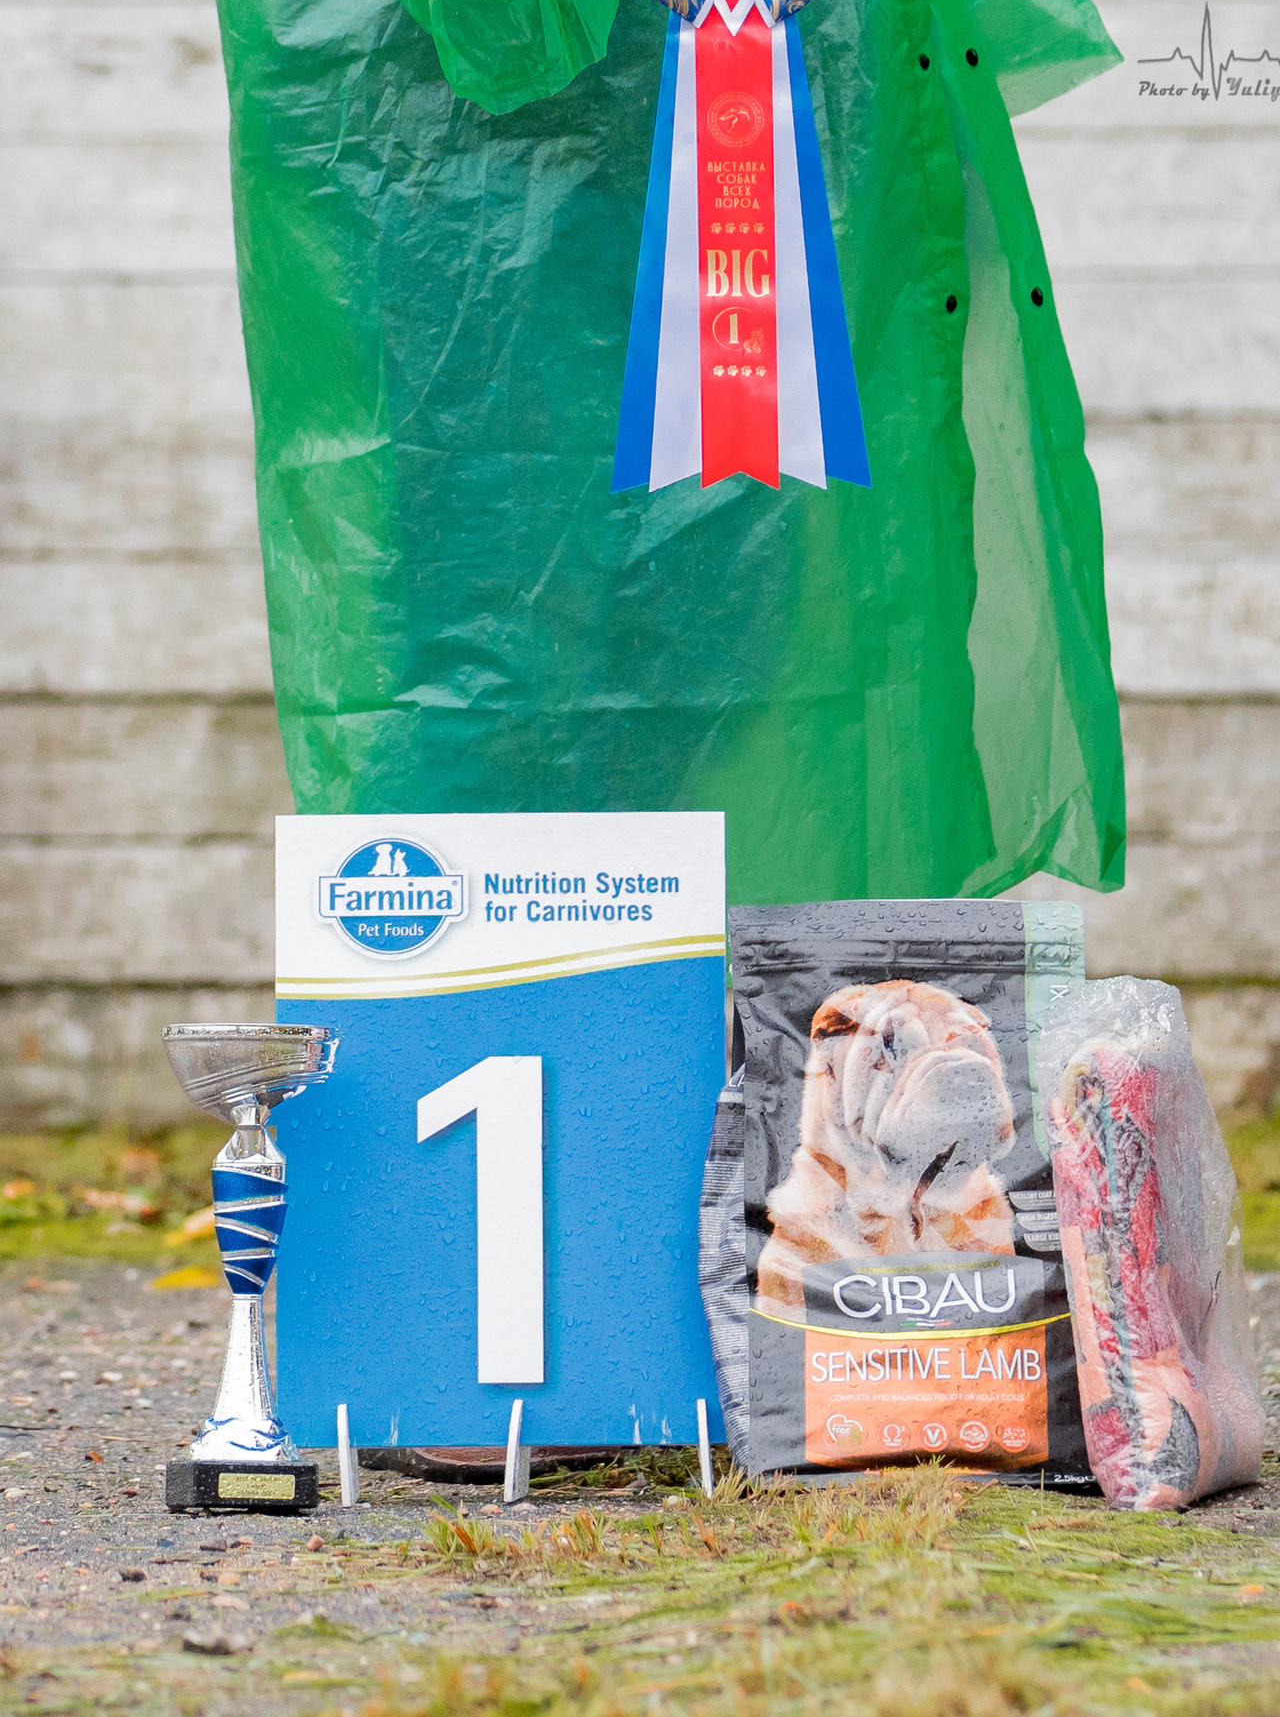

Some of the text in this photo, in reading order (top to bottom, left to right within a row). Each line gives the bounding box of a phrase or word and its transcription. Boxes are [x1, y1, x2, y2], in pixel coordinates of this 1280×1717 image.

[707, 161, 766, 173] ВЫСТАВКА
[716, 173, 758, 185] СОБАК
[723, 185, 752, 196] ВСЕХ
[715, 197, 760, 209] ПОРОД
[706, 248, 771, 298] BIG
[728, 312, 740, 345] 1
[329, 882, 453, 912] Farmina
[484, 871, 681, 899] Nutrition System
[484, 899, 653, 923] for Carnivores
[358, 922, 425, 937] Pet Foods
[416, 1055, 545, 1384] 1
[832, 1268, 1017, 1319] CIBAU
[810, 1346, 1043, 1383] SENSITIVE LAMB
[830, 1392, 1025, 1402] COMPLETE AND BALANCED FOOD FOR ADULT DOGS
[1054, 1474, 1085, 1484] 2.5kg
